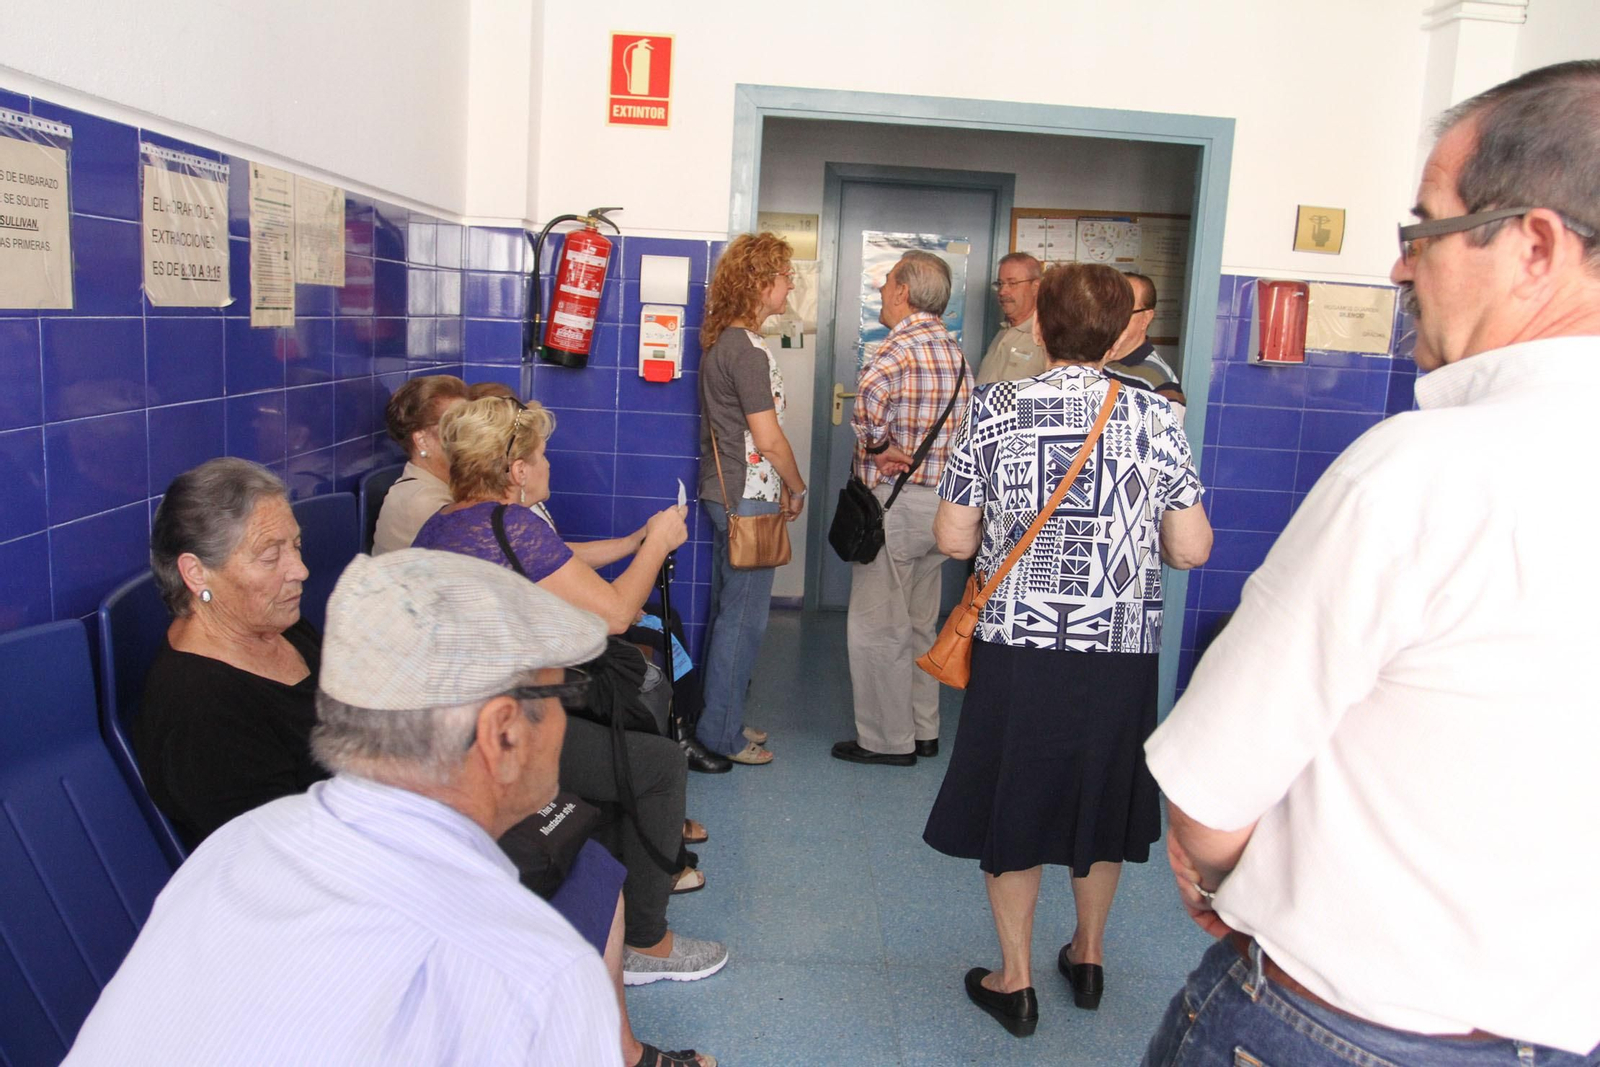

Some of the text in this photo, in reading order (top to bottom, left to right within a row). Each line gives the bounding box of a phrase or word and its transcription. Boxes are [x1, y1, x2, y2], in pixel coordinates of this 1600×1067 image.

[613, 104, 666, 120] EXTINTOR
[6, 170, 17, 182] DE
[19, 173, 59, 190] EMBARAZO
[4, 193, 49, 210] SE SOLICITE
[153, 196, 165, 213] EL
[12, 238, 53, 252] PRIMERAS.
[152, 228, 216, 249] EXTRACCIONES
[153, 260, 165, 276] ES
[166, 261, 179, 277] DE
[198, 264, 205, 277] A
[537, 806, 553, 817] This
[539, 813, 566, 836] Mustache
